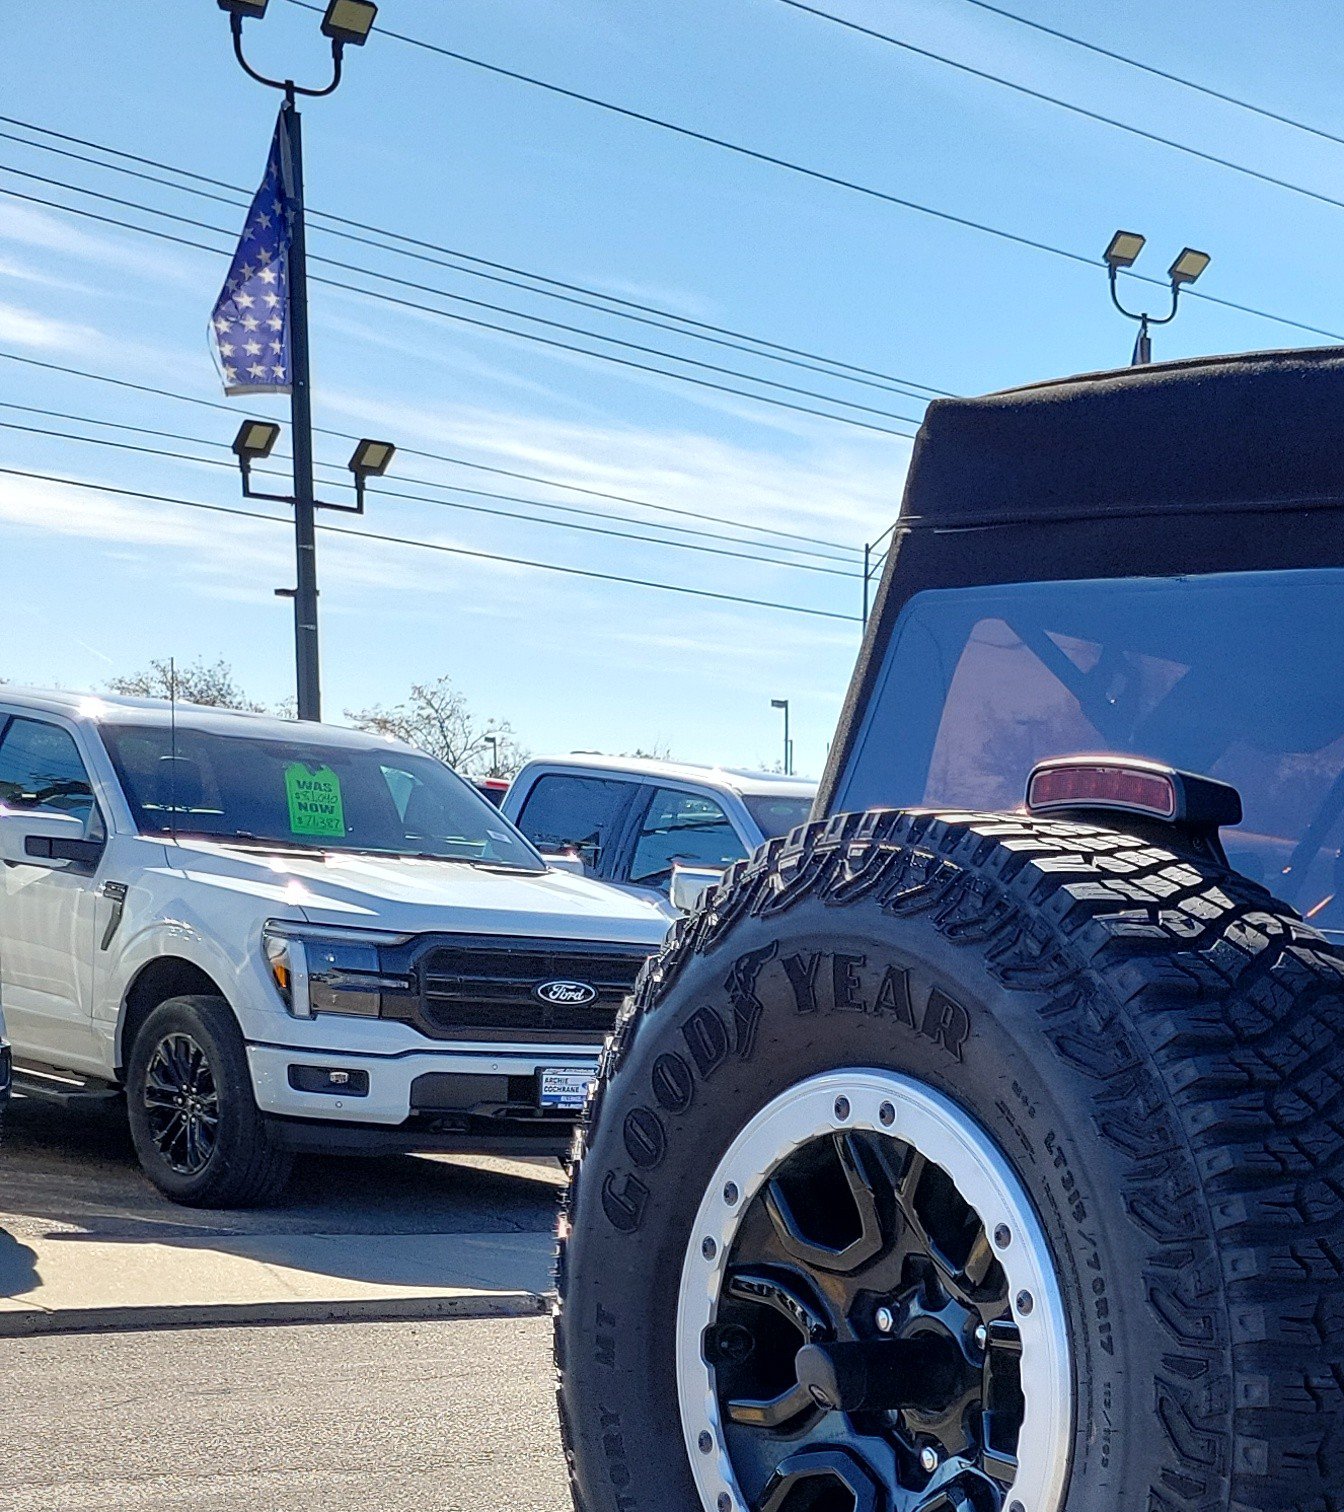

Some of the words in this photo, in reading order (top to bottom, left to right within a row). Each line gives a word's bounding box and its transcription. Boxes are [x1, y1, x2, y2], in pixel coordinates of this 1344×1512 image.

[296, 780, 333, 792] WAS
[298, 802, 335, 814] NOW
[547, 983, 586, 1002] Ford
[595, 1302, 616, 1368] MT
